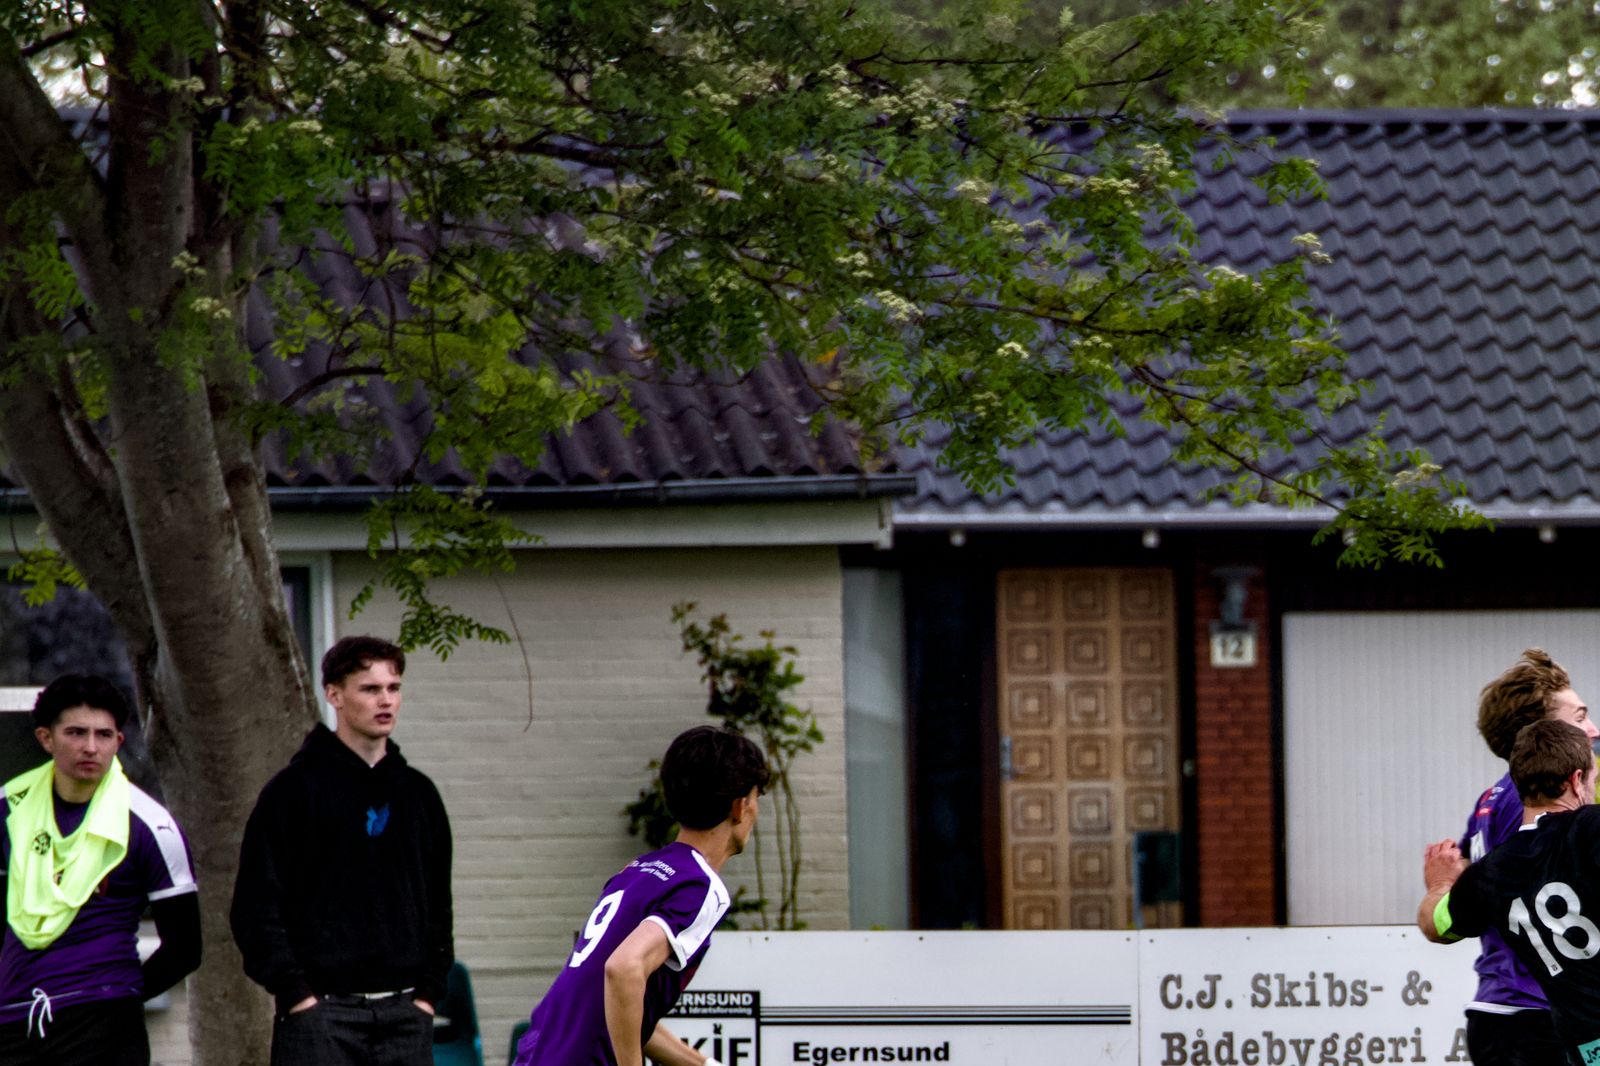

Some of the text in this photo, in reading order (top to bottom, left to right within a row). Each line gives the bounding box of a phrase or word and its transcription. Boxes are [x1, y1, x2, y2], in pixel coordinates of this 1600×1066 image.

[568, 889, 625, 968] 9
[1159, 970, 1432, 1010] C.J. Skibs- &
[792, 1041, 950, 1066] Egernsund
